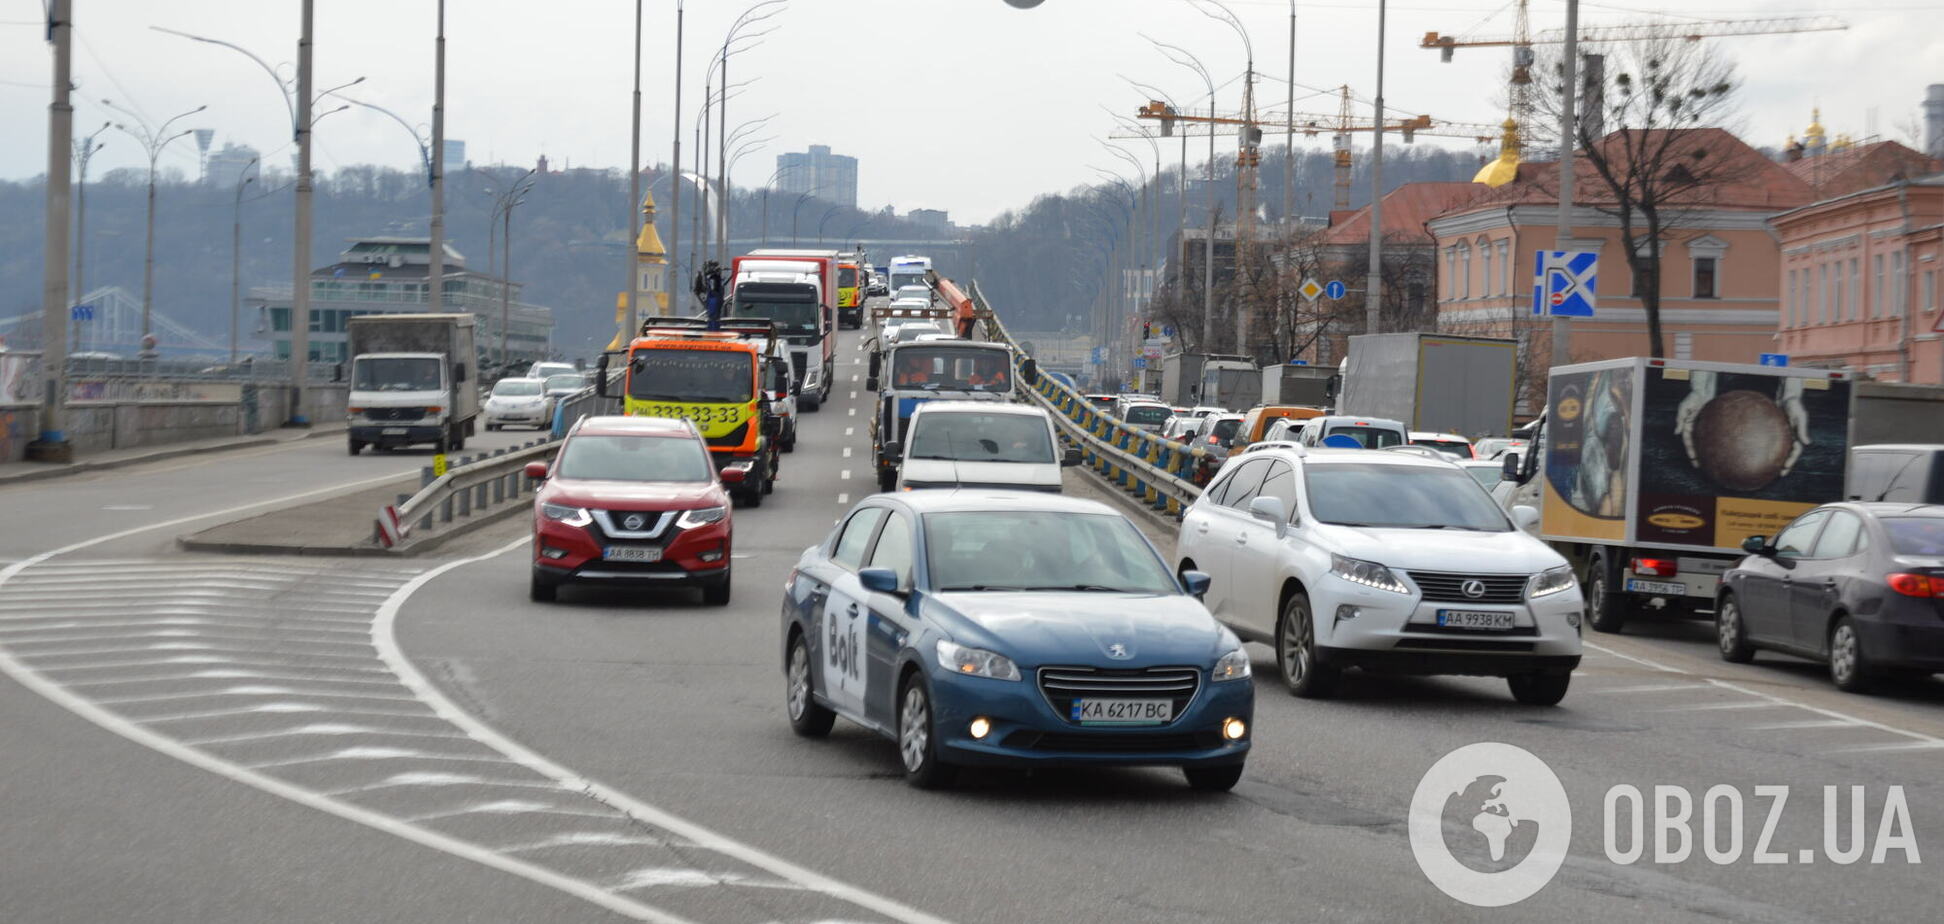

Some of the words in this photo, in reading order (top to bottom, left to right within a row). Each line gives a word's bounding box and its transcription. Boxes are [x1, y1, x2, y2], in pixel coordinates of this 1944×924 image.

[653, 405, 739, 423] 333-33-33
[1447, 612, 1462, 624] AA
[1465, 613, 1493, 626] 9938
[1494, 615, 1512, 627] KM
[1081, 702, 1103, 718] KA
[1108, 702, 1142, 719] 6217
[1145, 703, 1167, 718] BC
